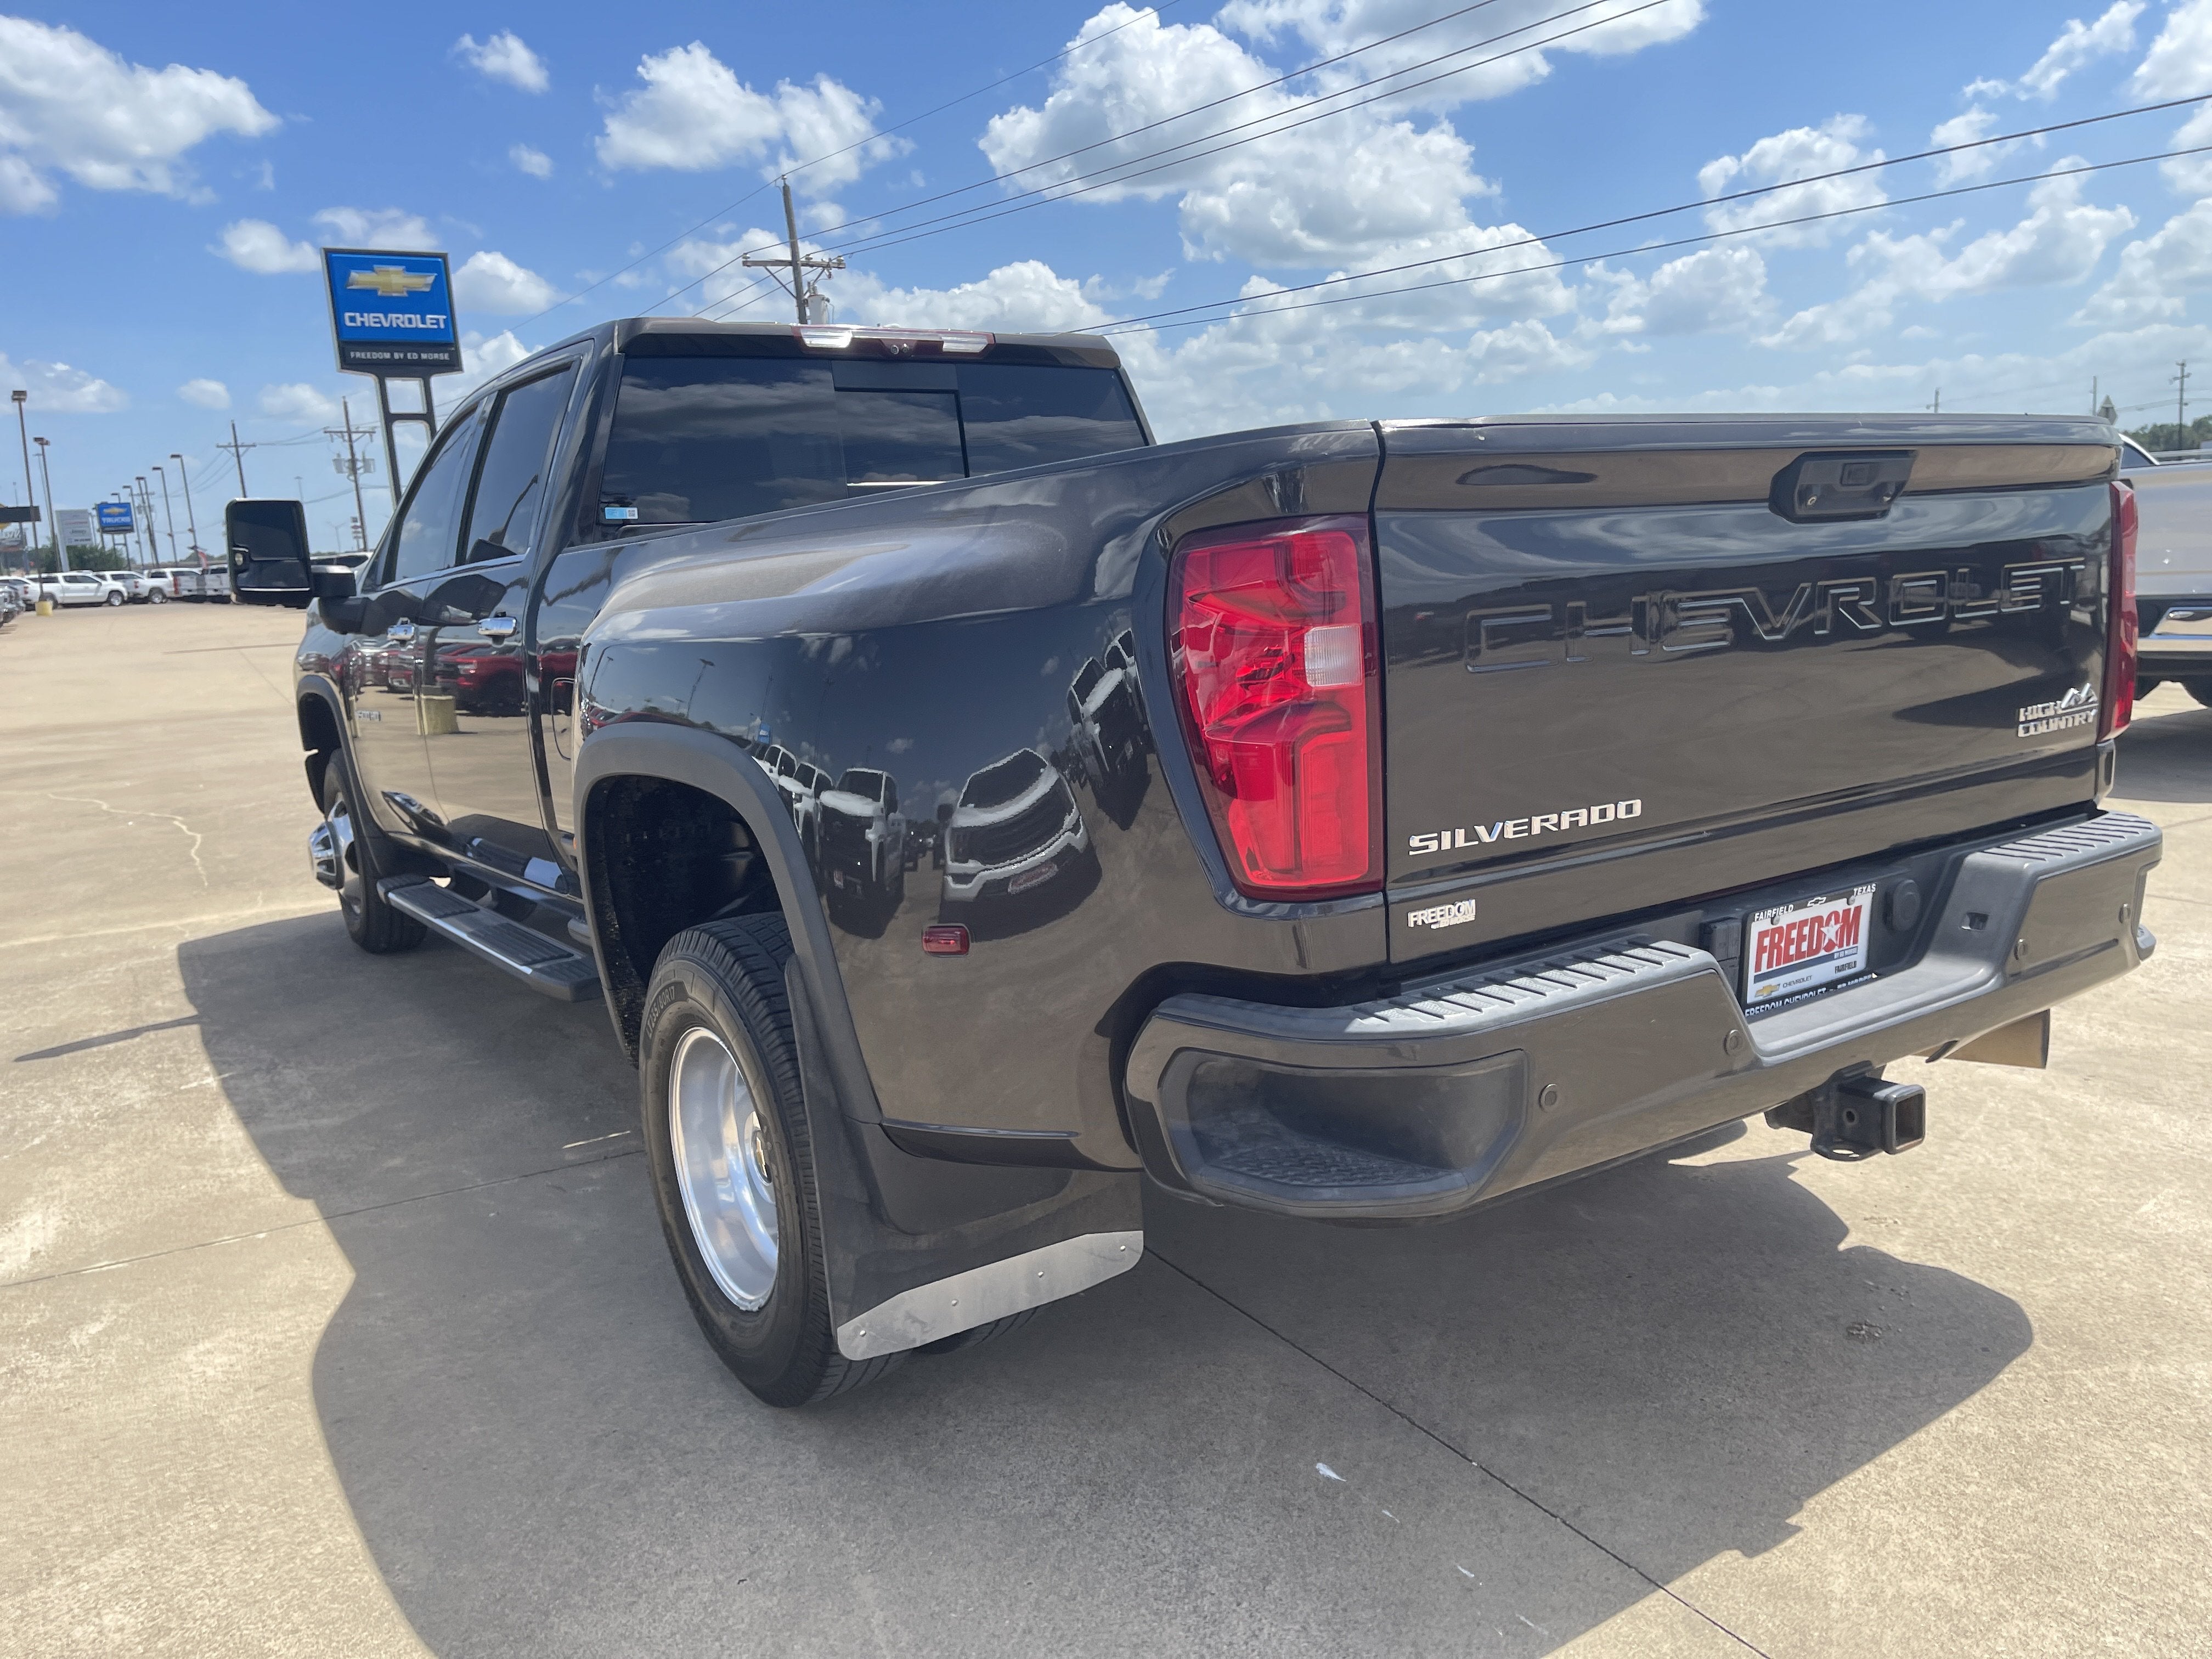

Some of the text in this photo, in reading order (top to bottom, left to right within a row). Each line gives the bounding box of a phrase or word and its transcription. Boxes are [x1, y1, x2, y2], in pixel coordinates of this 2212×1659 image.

[344, 312, 447, 329] CHEVROLET
[350, 351, 391, 359] FREEDOM
[393, 352, 404, 360] BY
[1465, 557, 2085, 673] CHEVROLET
[2018, 701, 2062, 722] HIGH
[2018, 709, 2098, 737] COUNTRY
[1409, 799, 1642, 855] SILVERADO
[1853, 883, 1877, 896] TEXAS
[1407, 899, 1476, 928] FREEDOM
[1754, 904, 1795, 922] FAIRFIELD
[1754, 905, 1863, 973] FREEDOM
[1835, 961, 1857, 974] FAIRFIELD
[1782, 975, 1813, 988] CHEVROLET
